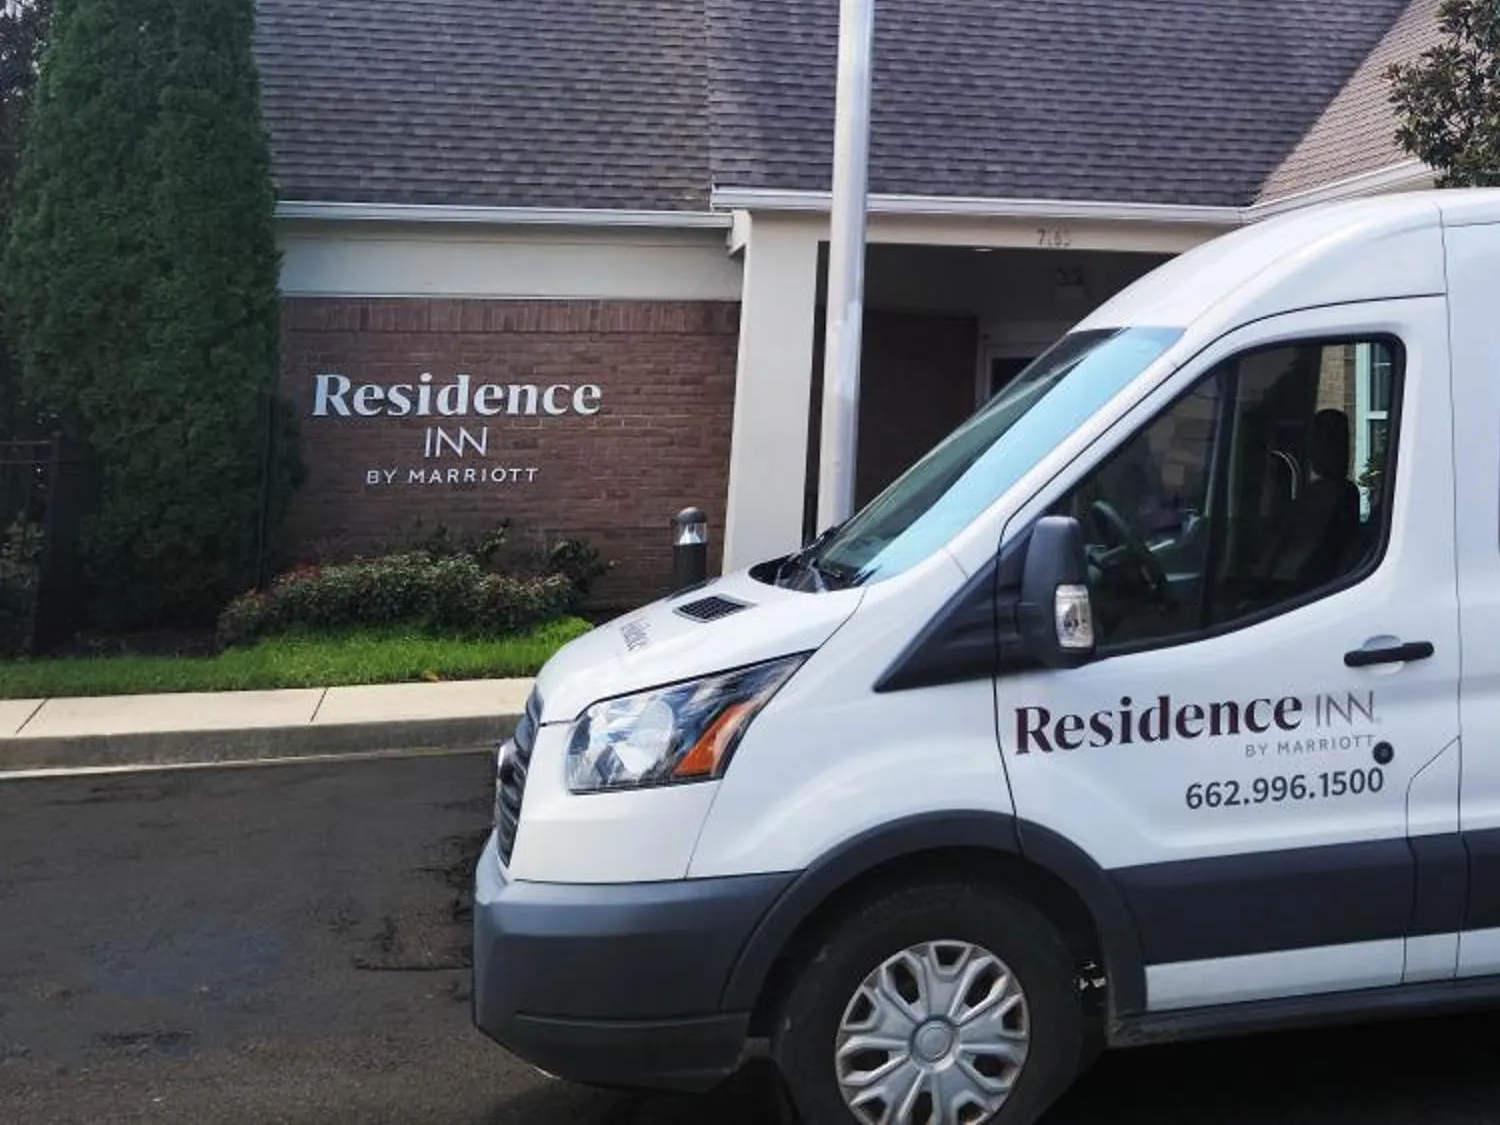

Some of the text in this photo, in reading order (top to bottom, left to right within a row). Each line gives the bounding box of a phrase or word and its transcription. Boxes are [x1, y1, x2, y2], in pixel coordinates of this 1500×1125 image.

[311, 372, 602, 416] Residence
[424, 426, 489, 458] INN
[366, 467, 540, 485] BY MARRIOTT
[1014, 689, 1377, 755] Residence INN
[1245, 733, 1377, 759] BY MARRIOTT
[1184, 766, 1385, 810] 662.996.1500
